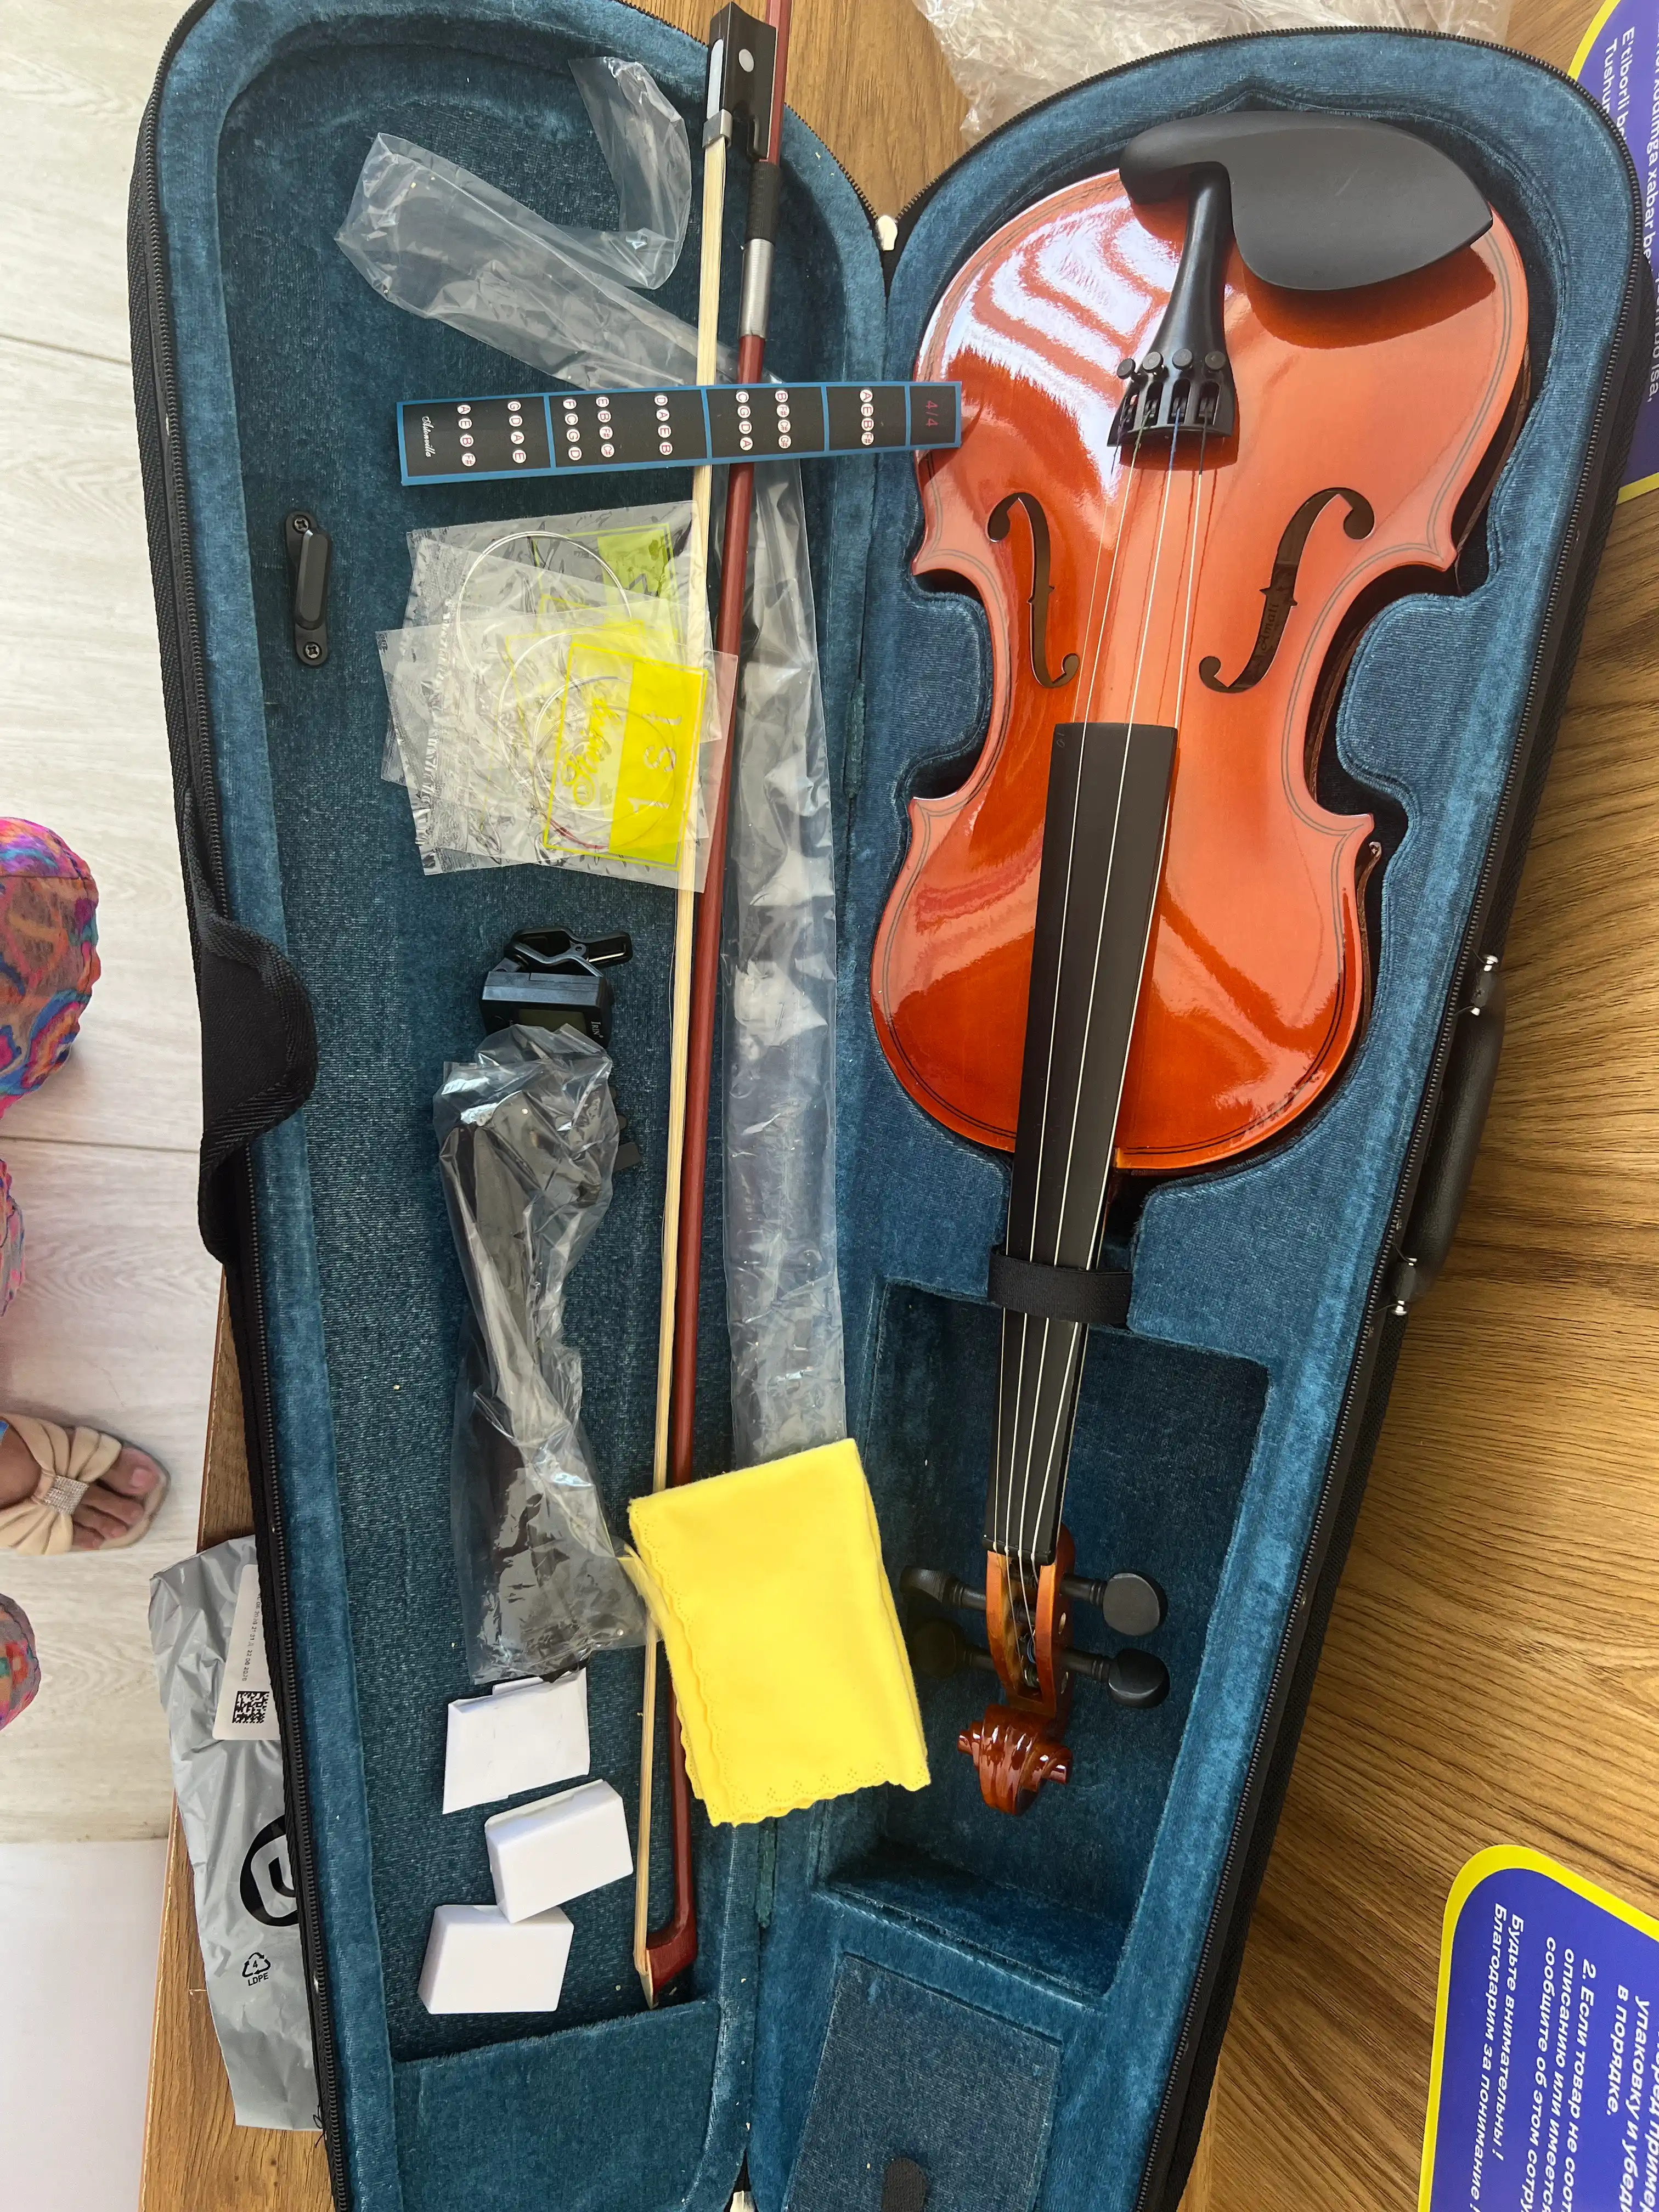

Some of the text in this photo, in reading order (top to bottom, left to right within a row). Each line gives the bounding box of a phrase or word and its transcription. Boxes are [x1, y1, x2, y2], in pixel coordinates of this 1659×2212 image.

[1617, 27, 1635, 111] E'tiborli
[1644, 167, 1659, 229] xabar
[926, 400, 939, 427] 4/4
[1259, 603, 1279, 651] Amati
[247, 1972, 269, 1986] LDPE
[252, 1960, 258, 1968] 4
[1485, 1904, 1507, 2041] Благодарим
[1507, 1914, 1524, 1991] Будьте
[1555, 1949, 1575, 2068] описанию
[1482, 2043, 1492, 2070] за
[1493, 1994, 1515, 2147] внимательны
[1520, 1937, 1556, 2212] сообщите об этом сотру
[1561, 1959, 1596, 2212] 2. Если товар не соот
[1606, 1984, 1629, 2115] в порядке.
[1626, 1996, 1650, 2120] упаковку
[1551, 2071, 1564, 2117] или
[1627, 2120, 1639, 2140] и
[1471, 2074, 1490, 2200] понимание
